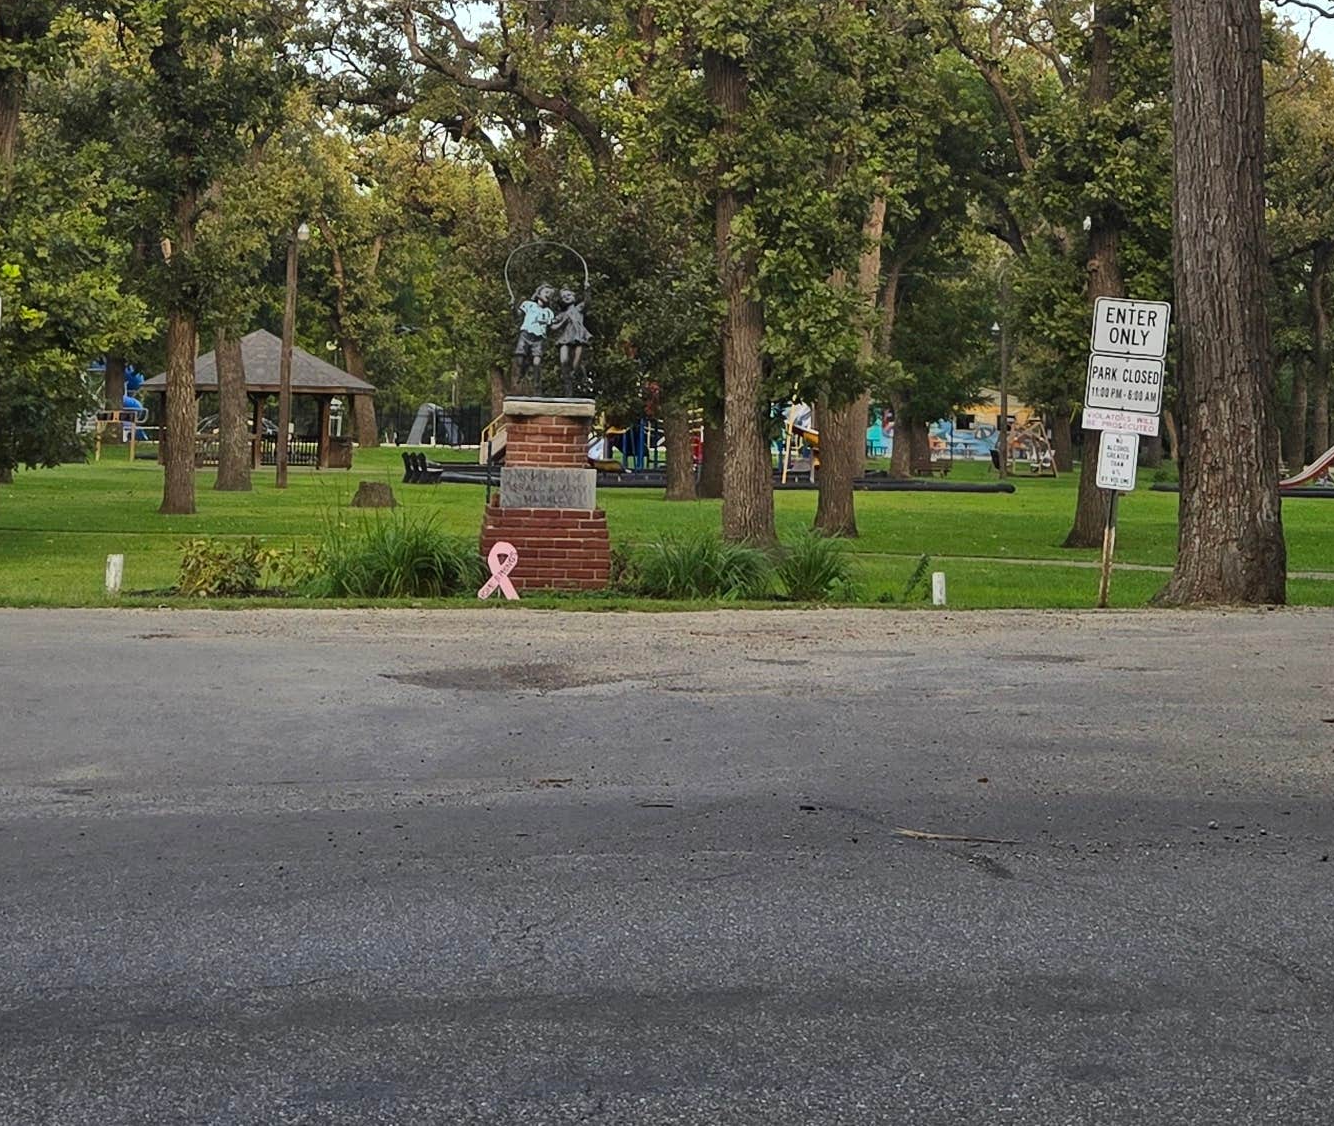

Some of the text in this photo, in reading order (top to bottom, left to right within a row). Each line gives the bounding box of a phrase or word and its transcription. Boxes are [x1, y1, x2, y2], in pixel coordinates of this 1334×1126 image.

[1106, 307, 1158, 327] ENTER
[1109, 327, 1150, 346] ONLY
[1092, 366, 1159, 385] PARK CLOSED
[1110, 388, 1122, 399] PM
[1144, 391, 1157, 402] AM
